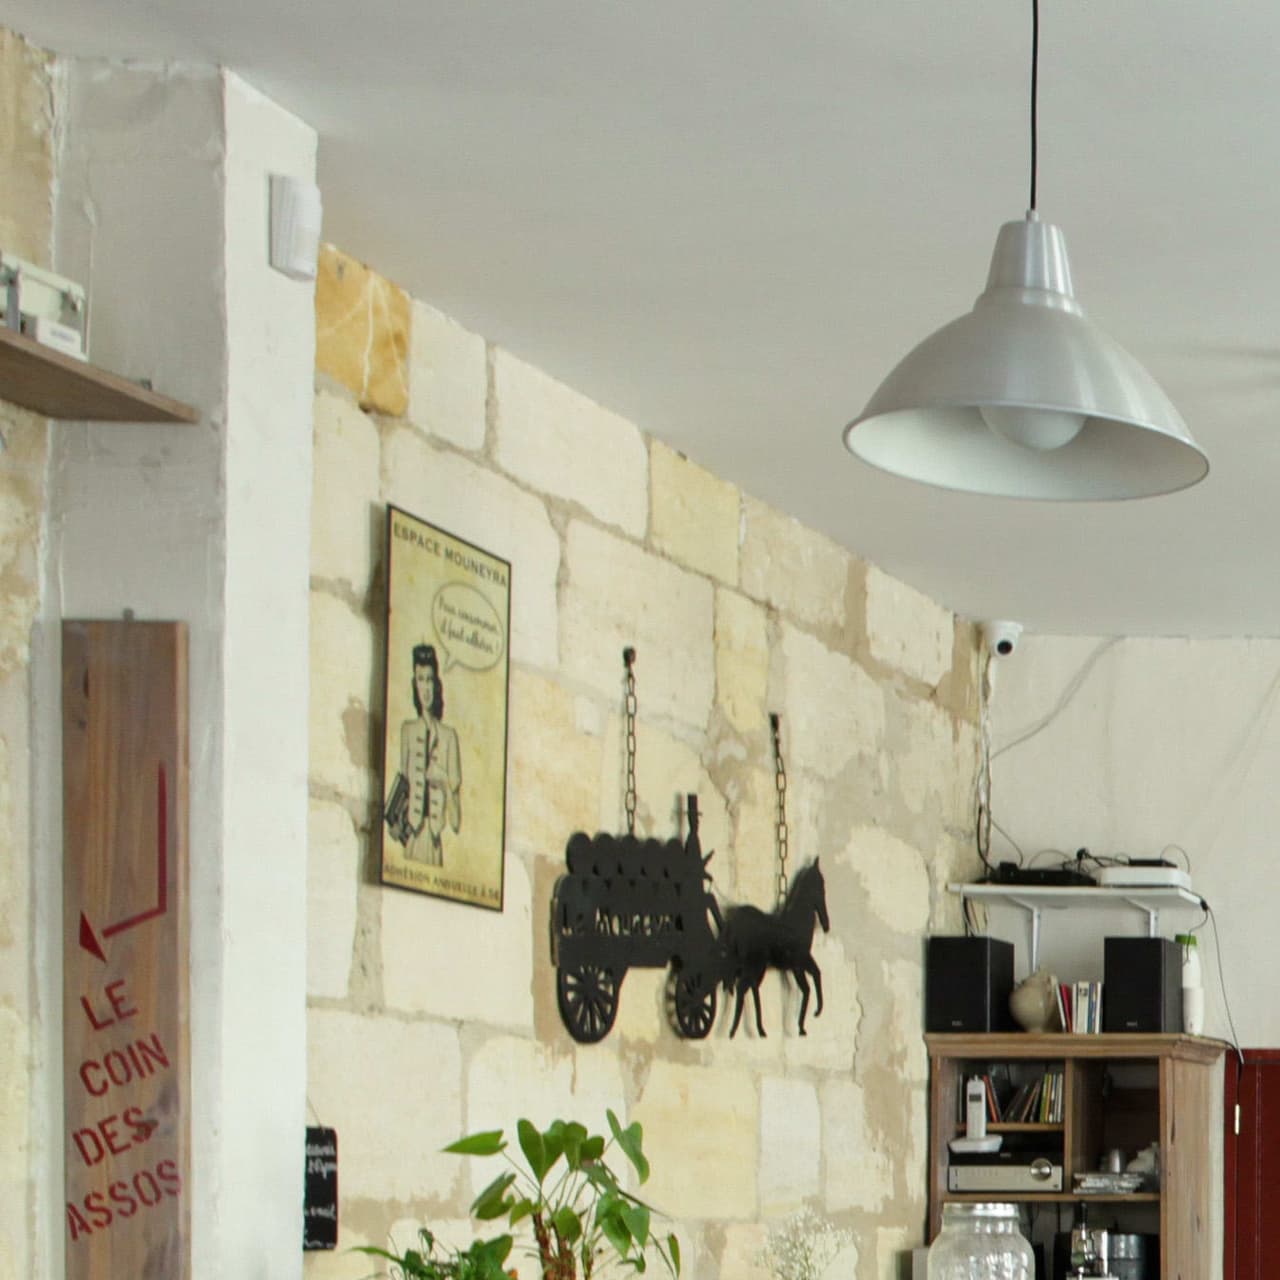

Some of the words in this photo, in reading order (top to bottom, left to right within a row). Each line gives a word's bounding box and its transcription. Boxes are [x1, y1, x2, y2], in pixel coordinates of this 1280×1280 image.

[393, 520, 442, 557] ESPACE
[444, 545, 506, 588] MOUNEYRA
[595, 903, 685, 940] Mouneyra
[79, 978, 139, 1031] LE
[78, 1032, 171, 1098] COIN
[72, 1106, 154, 1168] DES
[65, 1159, 182, 1241] ASSOS
